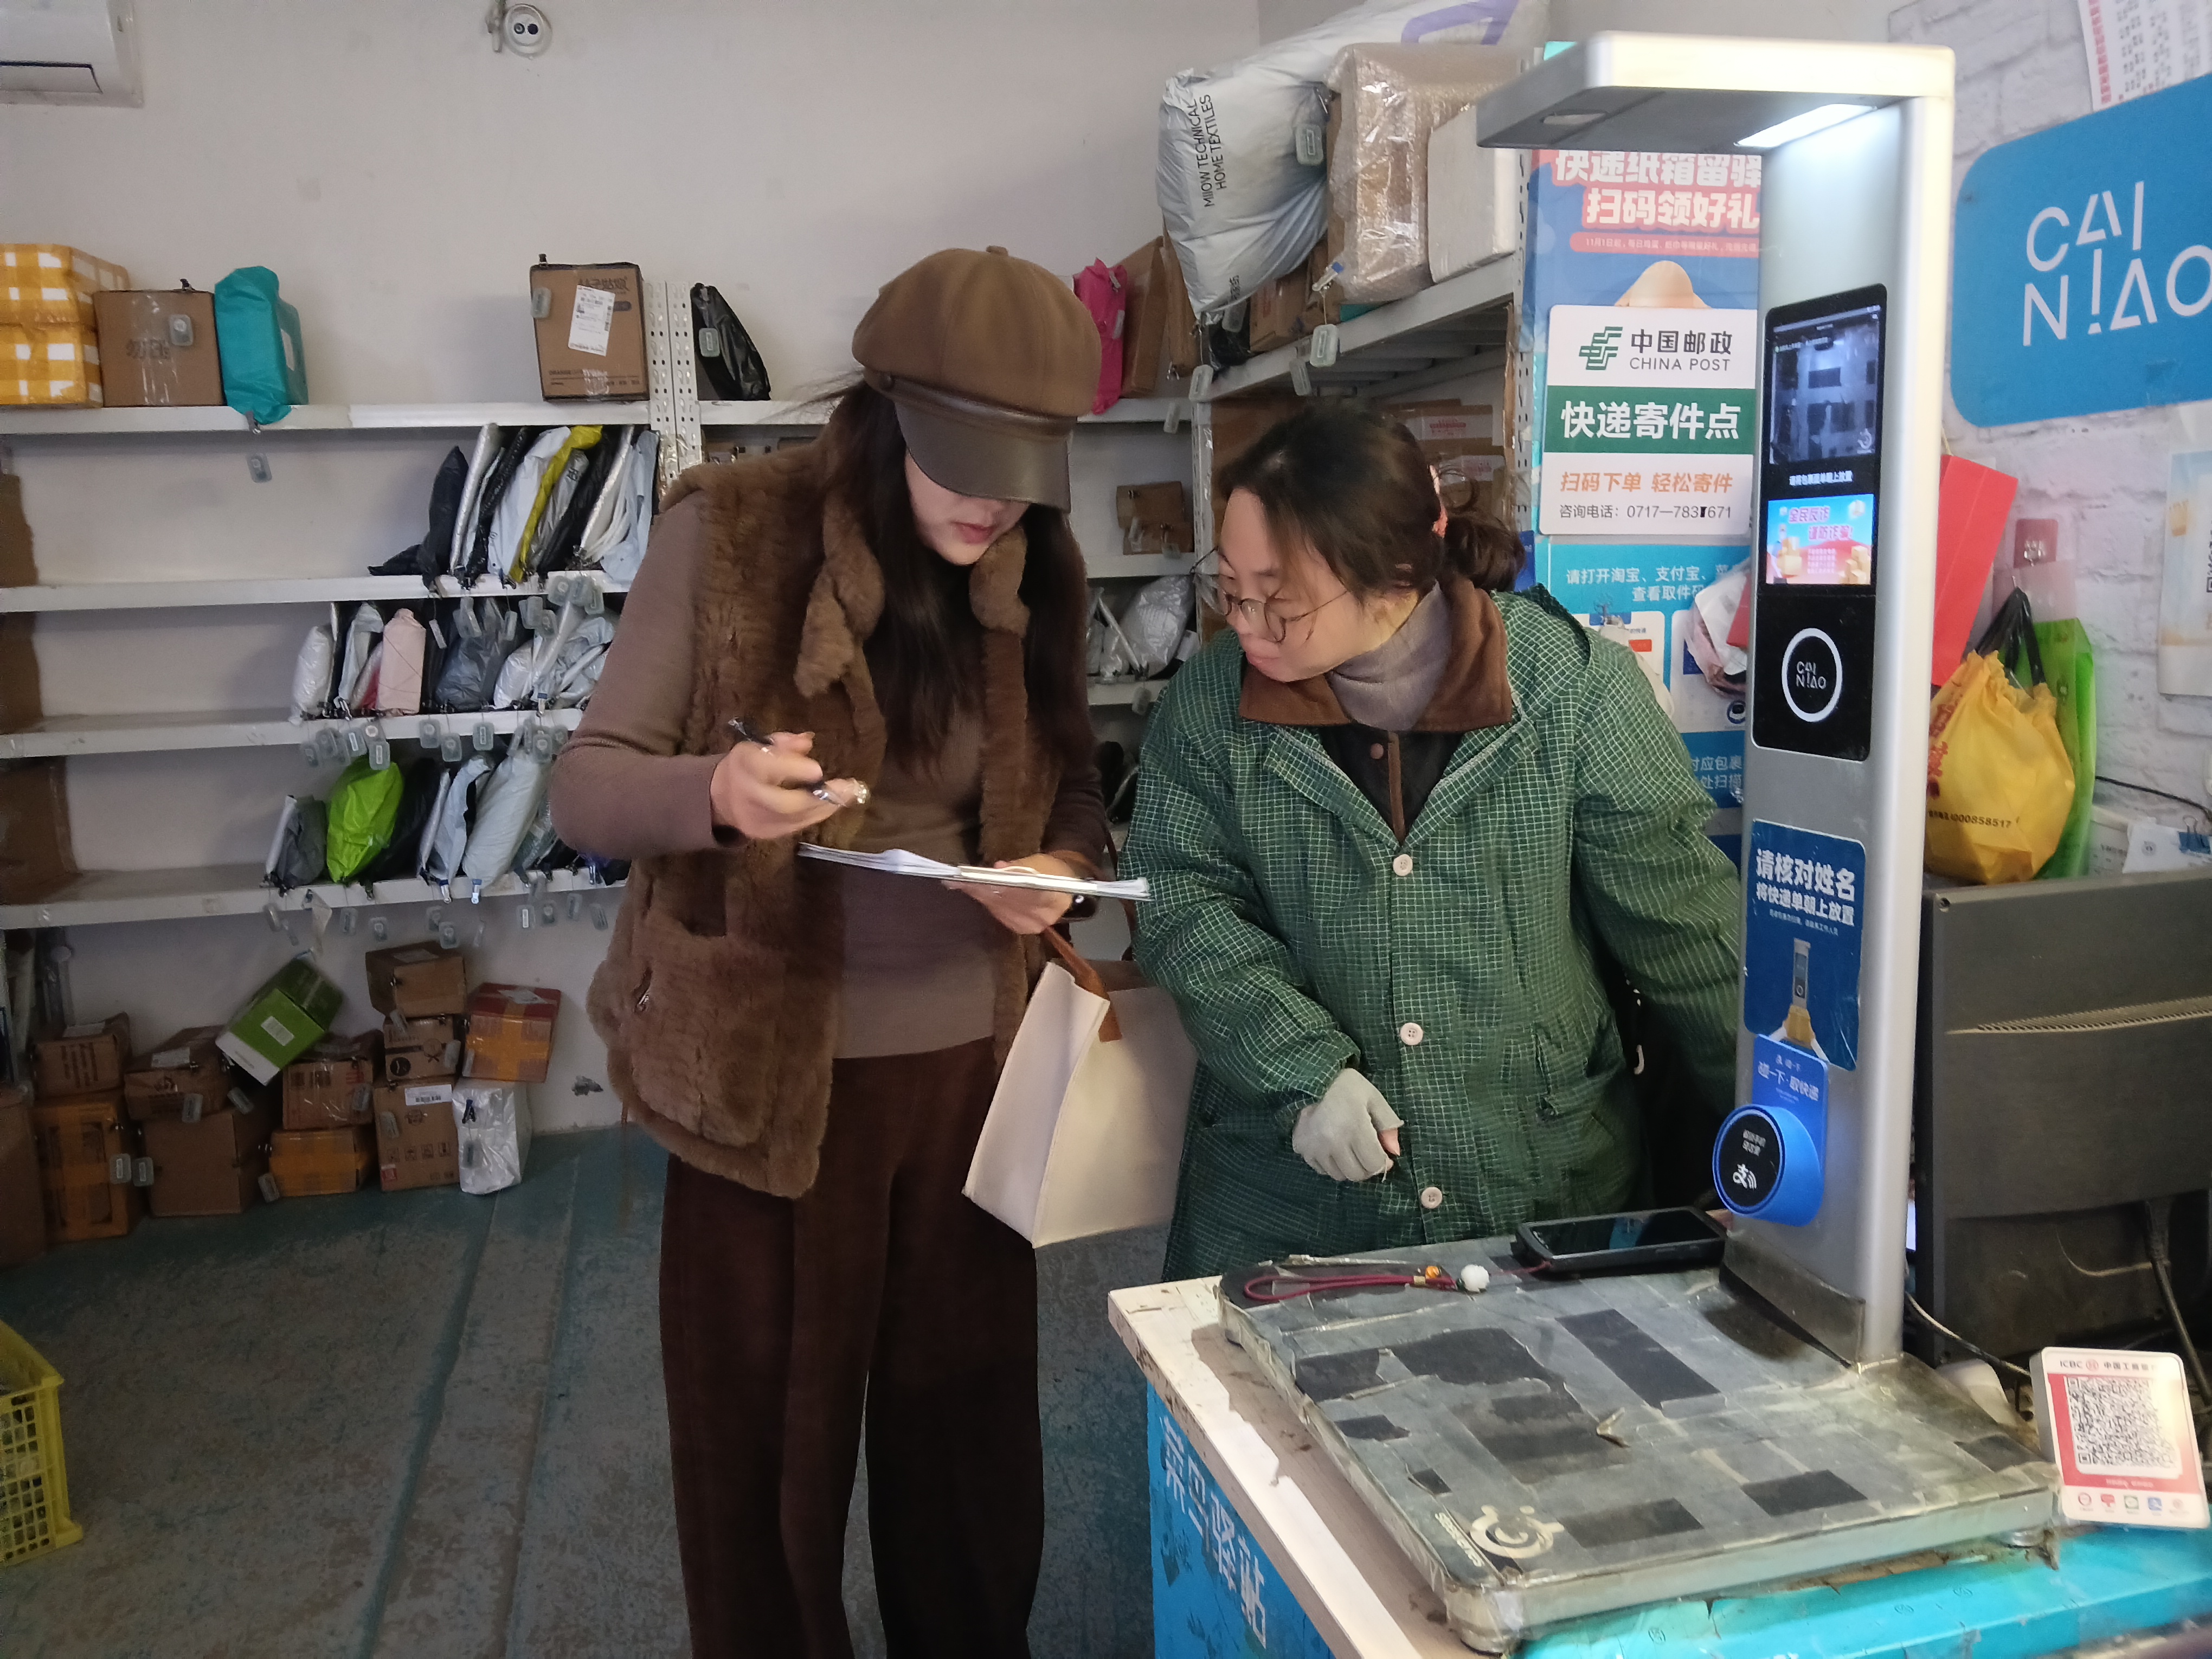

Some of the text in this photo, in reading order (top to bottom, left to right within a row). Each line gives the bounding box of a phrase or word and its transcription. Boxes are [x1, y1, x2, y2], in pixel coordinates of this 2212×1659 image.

[1187, 99, 1208, 169] TECHNICAL
[1199, 94, 1227, 190] HOME TEXTILES
[1587, 188, 1760, 229] 扫码领好礼
[2026, 181, 2145, 272] CAI
[1631, 329, 1732, 355] 中国邮政
[1630, 357, 1731, 371] CHINA POST
[1561, 400, 1741, 440] 快递寄件点
[1560, 472, 1733, 494] 扫码下单 轻松寄件
[1796, 661, 1816, 675] CAI
[1756, 848, 1855, 902] 请核对姓名
[1756, 882, 1855, 927] 将快递单朝上放置
